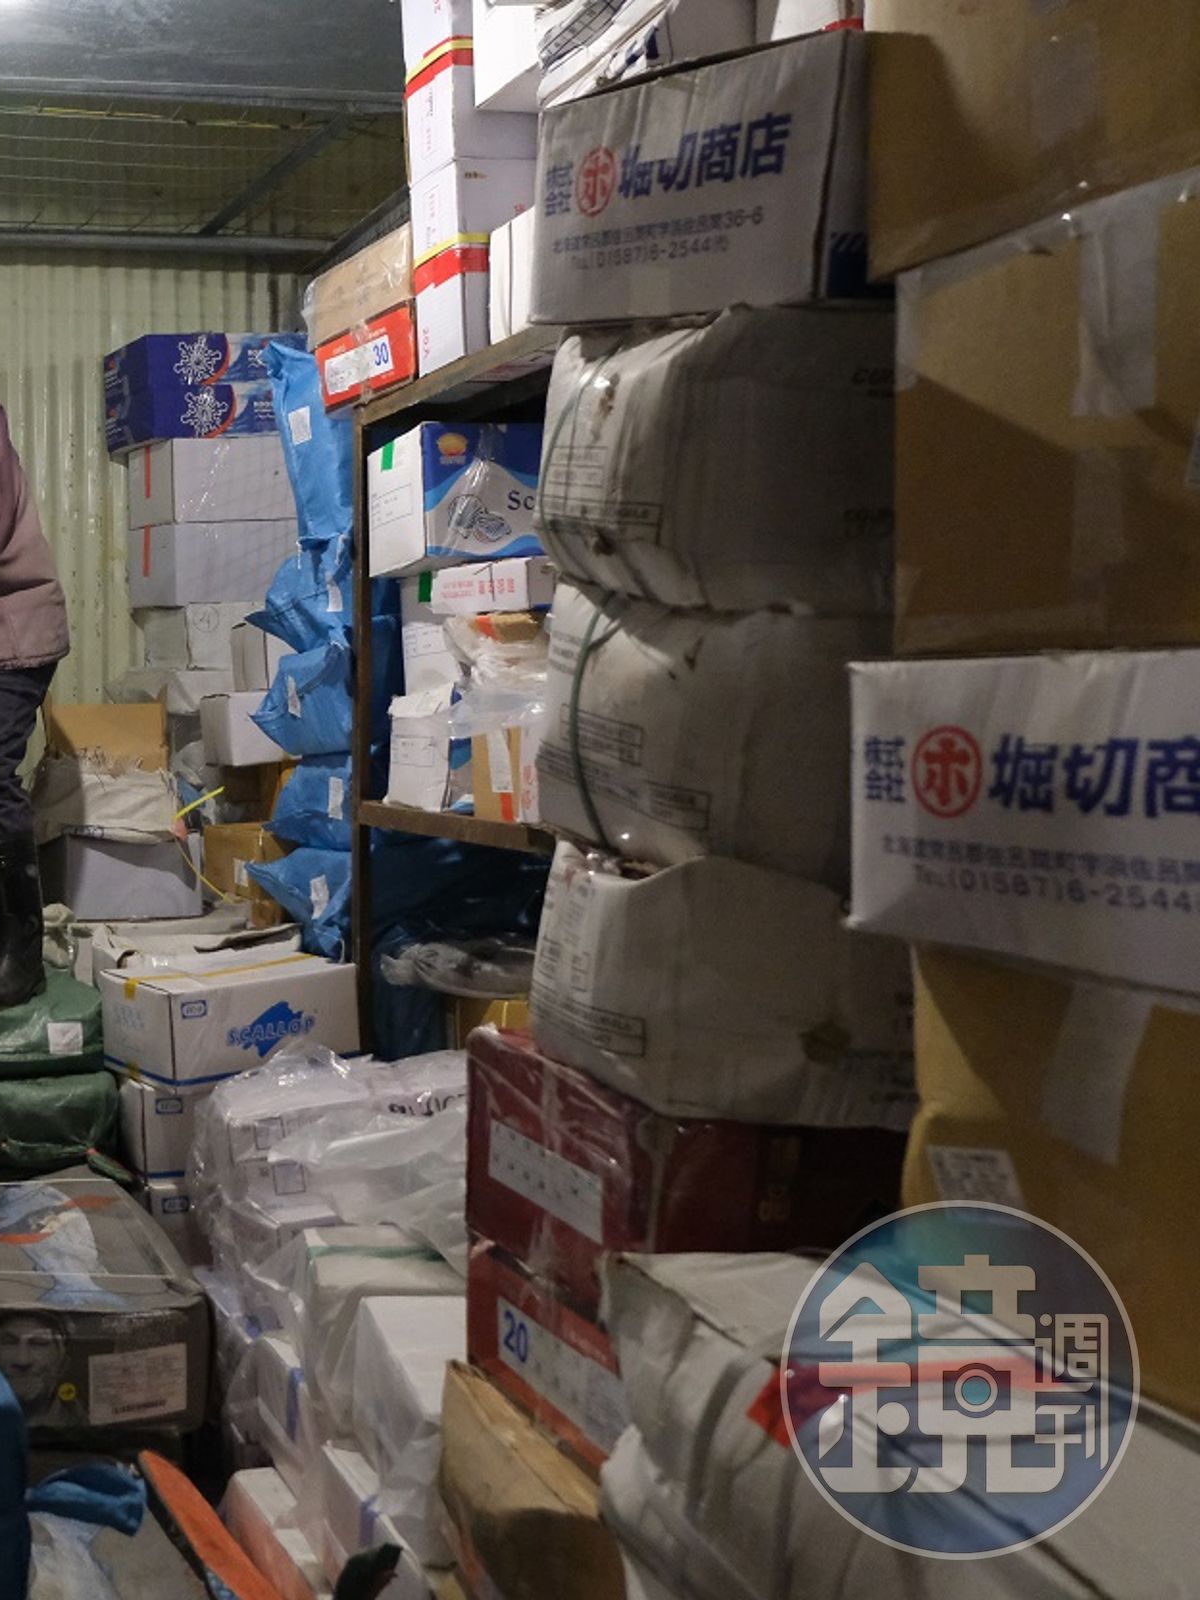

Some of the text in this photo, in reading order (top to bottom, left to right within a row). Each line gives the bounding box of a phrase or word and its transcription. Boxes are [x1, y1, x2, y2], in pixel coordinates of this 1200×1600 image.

[373, 342, 389, 367] 30
[226, 1014, 316, 1047] SCALLOP
[503, 1310, 528, 1363] 20
